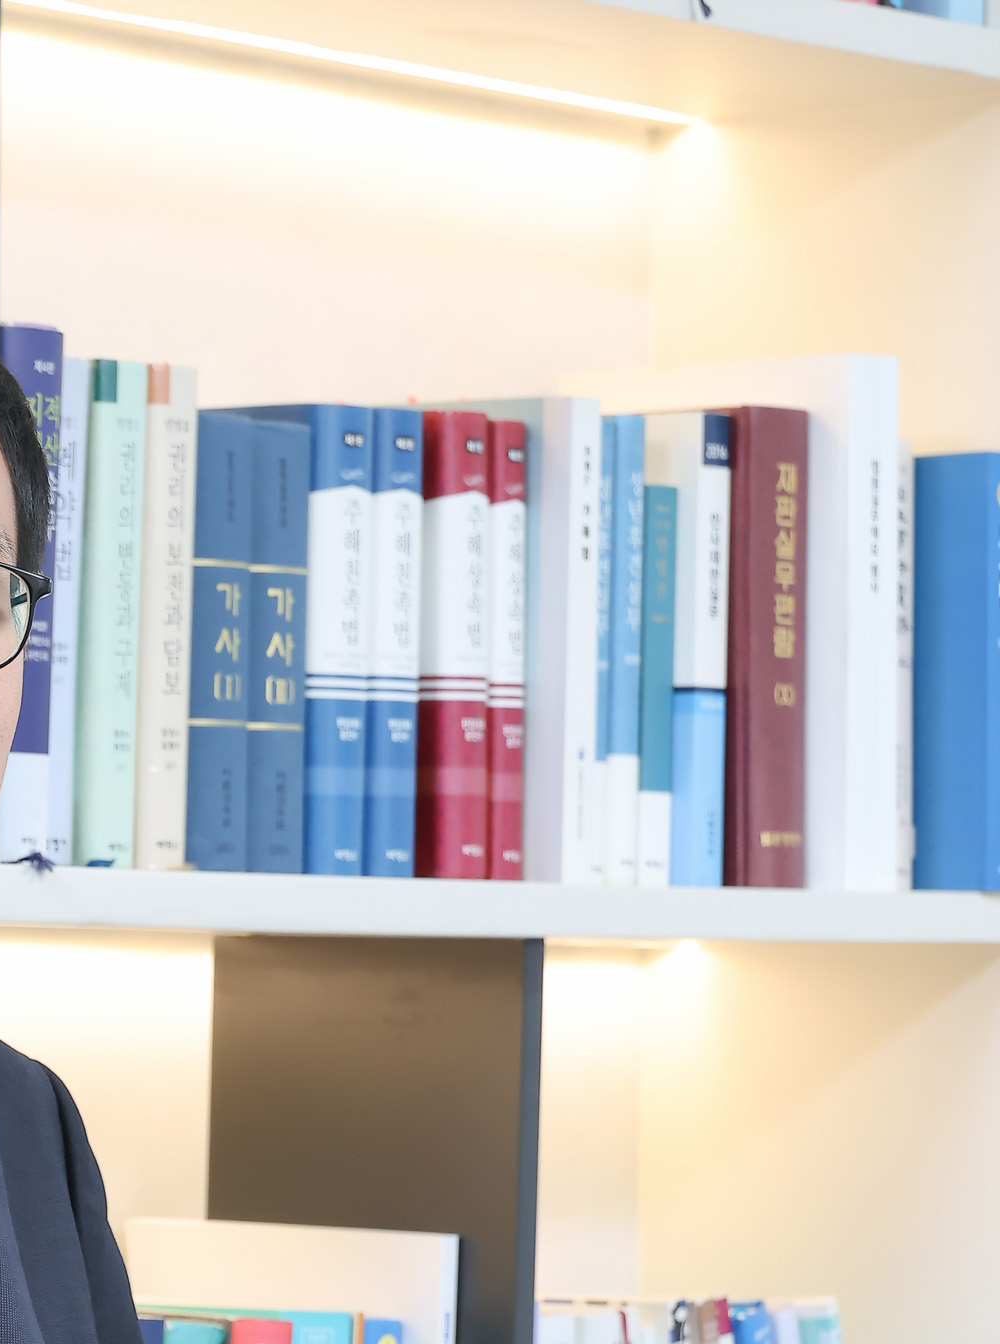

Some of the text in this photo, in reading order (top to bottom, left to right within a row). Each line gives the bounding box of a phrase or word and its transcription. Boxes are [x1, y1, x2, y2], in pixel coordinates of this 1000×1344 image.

[774, 463, 798, 659] 재판실무편람
[214, 582, 242, 662] 가사
[265, 586, 295, 667] 가사
